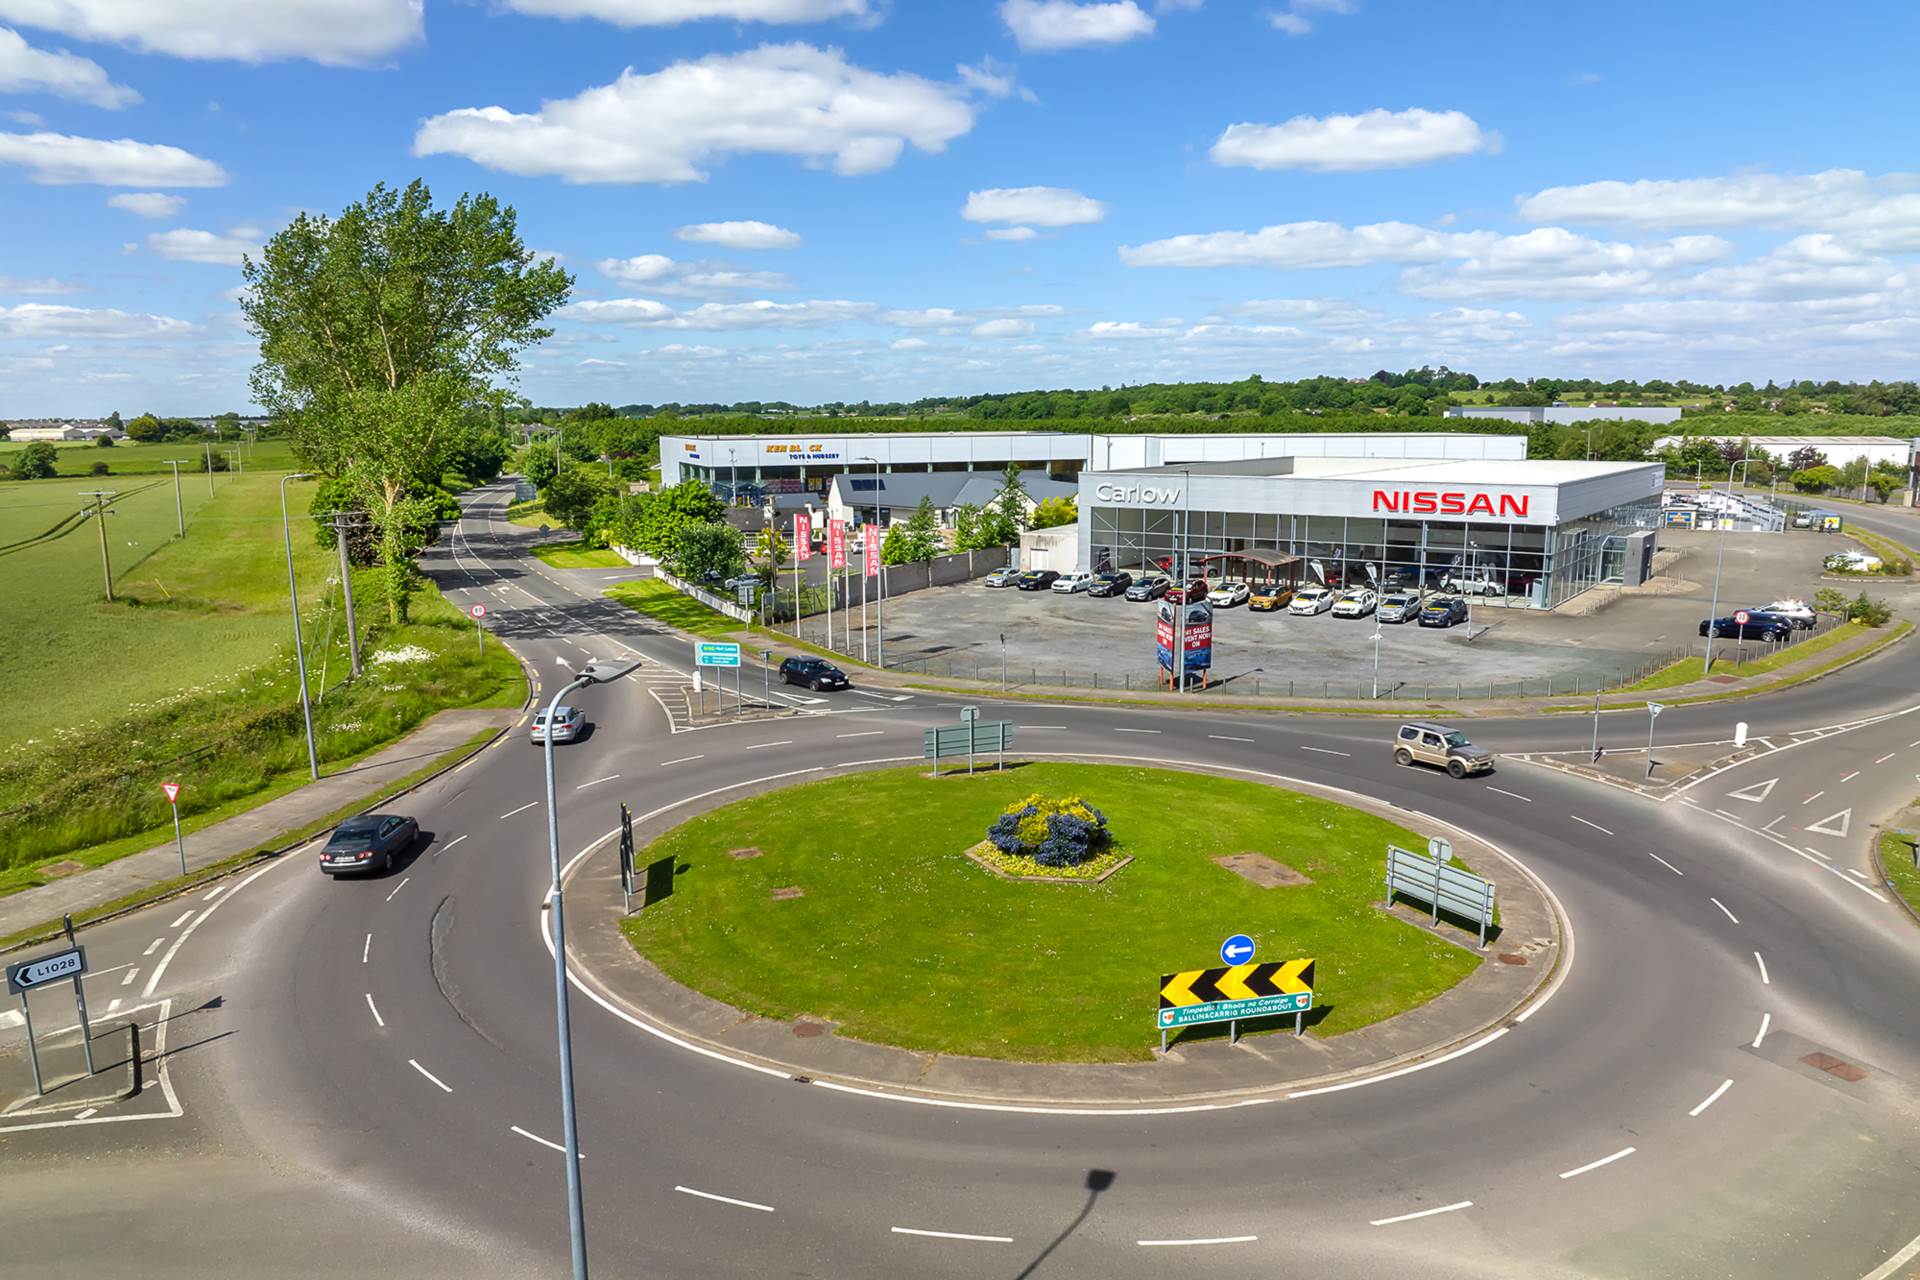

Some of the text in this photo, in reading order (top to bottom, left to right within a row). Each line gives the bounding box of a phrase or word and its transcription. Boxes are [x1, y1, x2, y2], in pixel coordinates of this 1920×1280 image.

[1096, 482, 1180, 504] Carlow
[1373, 490, 1529, 517] NISSAN
[799, 516, 809, 559] NISSAN
[832, 522, 844, 567] NISSAN
[869, 528, 879, 575] NISSAN
[37, 958, 76, 977] L1028
[1178, 1003, 1292, 1023] BALLINACARRIG ROUNDABOUT
